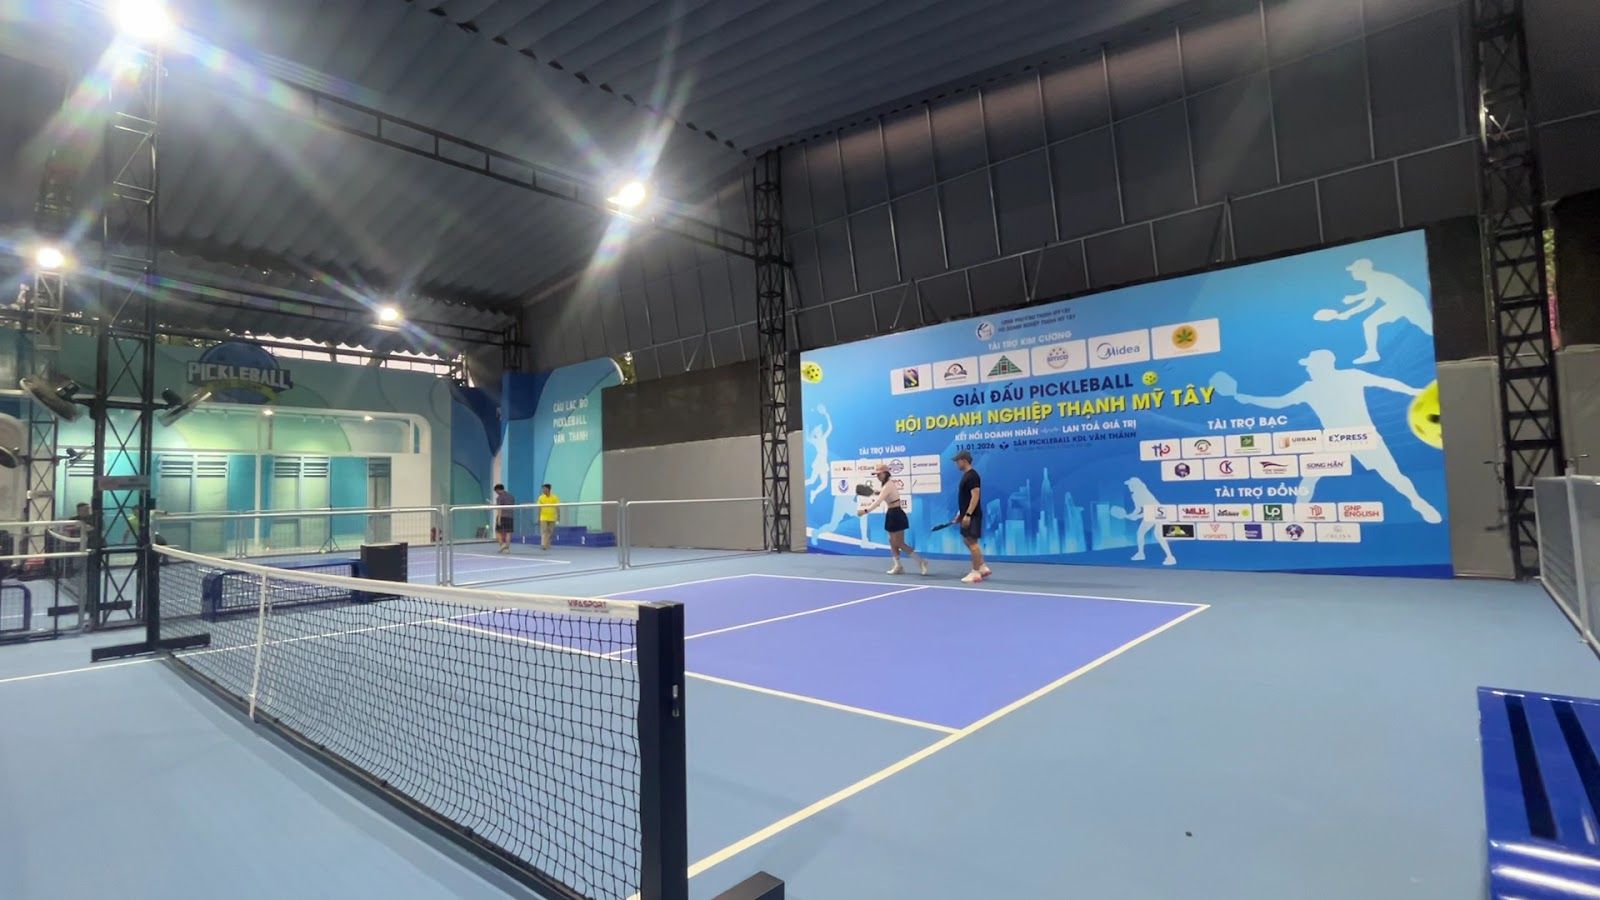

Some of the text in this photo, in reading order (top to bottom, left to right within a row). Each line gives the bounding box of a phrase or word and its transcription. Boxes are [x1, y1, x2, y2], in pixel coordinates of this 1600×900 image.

[988, 330, 1072, 350] TÀI TRỢ KIM CƯƠNG
[1099, 342, 1140, 359] Midea
[188, 362, 291, 390] PICKLEBALL
[953, 373, 1134, 407] GIẢI ĐẤU PICKLEBALL
[896, 384, 1215, 435] HỘI DOANH NGHIỆP THẠNH MỸ TÂY
[552, 416, 588, 428] PICKLEBALL
[954, 431, 967, 441] KẾT
[968, 430, 983, 440] NỐI
[984, 430, 1012, 439] DOANH
[1014, 427, 1039, 436] NHÂN
[1062, 424, 1079, 433] LAN
[1122, 420, 1136, 430] TRỊ
[1208, 415, 1288, 430] TÀI TRỢ BẠC
[1029, 436, 1070, 445] PICKLEBALL
[1072, 434, 1088, 442] KDL
[1328, 434, 1368, 442] EXPRESS
[859, 444, 906, 456] TÀI TRỢ VÀNG
[1214, 482, 1310, 500] TÀI TRỢ ĐỒNG
